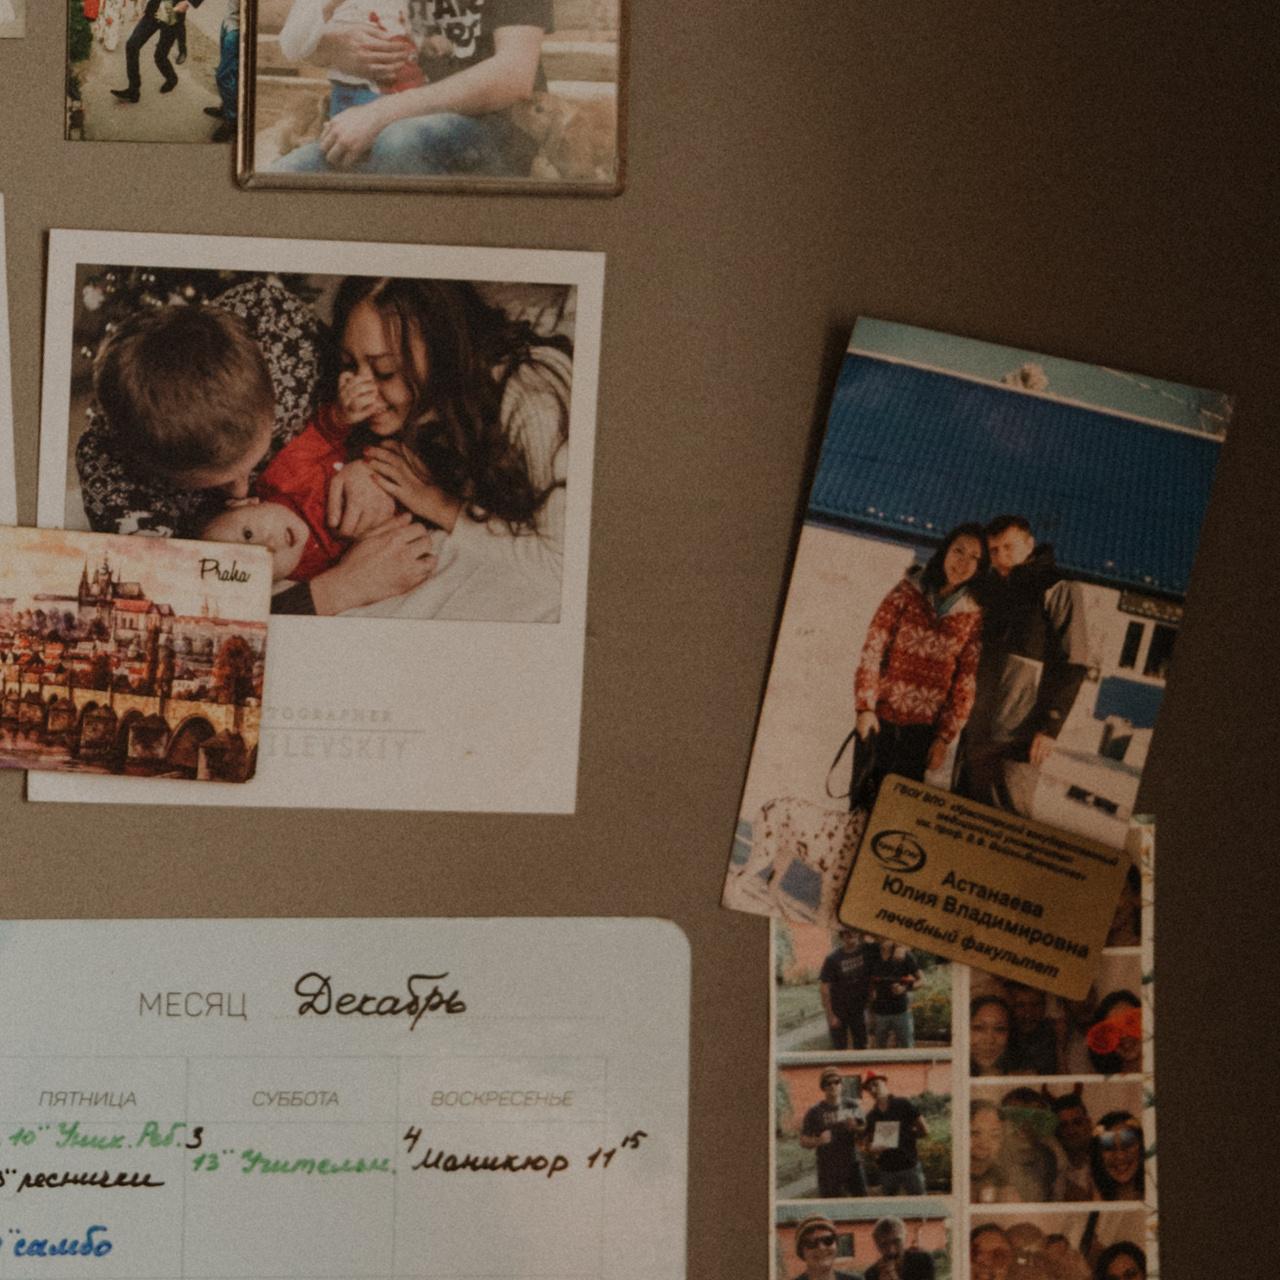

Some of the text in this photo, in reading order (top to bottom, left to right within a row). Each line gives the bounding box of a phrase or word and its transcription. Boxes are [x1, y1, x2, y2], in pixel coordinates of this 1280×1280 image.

[198, 558, 251, 585] Praha
[942, 870, 1044, 919] Астанаева
[881, 874, 1090, 960] Юлия Владимировна
[874, 908, 1061, 980] лечебный факультет
[138, 991, 249, 1022] МЕСЯЦ
[294, 971, 469, 1031] Декабрь
[39, 1090, 137, 1111] ПЯТНИЦА
[252, 1089, 340, 1109] СУББОТА
[430, 1088, 576, 1108] ВОСКРЕСЕНЬЕ
